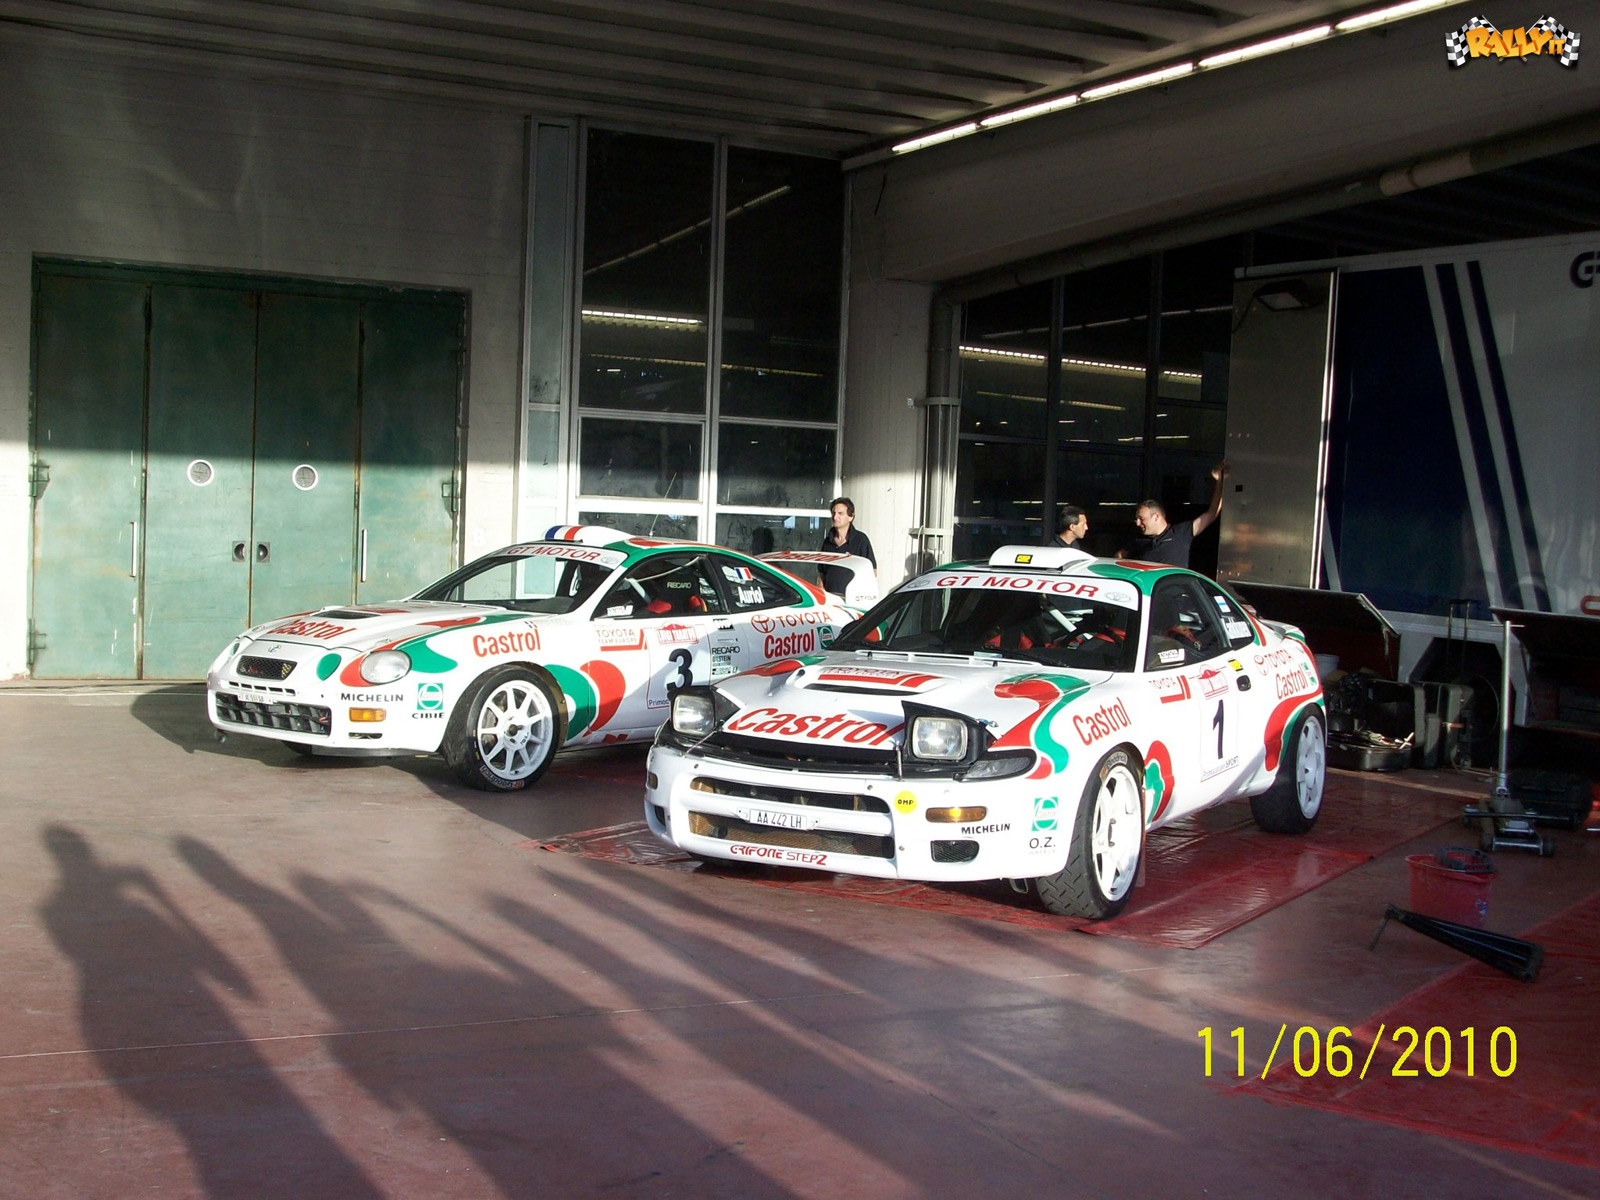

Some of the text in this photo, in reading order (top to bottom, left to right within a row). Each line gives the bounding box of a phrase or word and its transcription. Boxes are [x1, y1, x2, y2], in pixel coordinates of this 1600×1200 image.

[507, 546, 601, 561] GT MOTOR
[667, 581, 692, 589] RECARO
[936, 576, 1099, 597] GT MOTOR
[738, 586, 765, 604] Auriol
[776, 611, 833, 628] TOYOTA
[266, 618, 357, 640] Castrol
[596, 629, 635, 638] TOYOTA
[472, 628, 541, 657] Castrol
[711, 645, 741, 655] RECARO
[764, 629, 815, 659] Castrol
[666, 648, 693, 692] 3
[1276, 664, 1309, 700] Castrol
[340, 692, 404, 702] MICHELIN
[728, 707, 904, 746] Castrol
[1072, 696, 1132, 746] Castrol
[1212, 698, 1225, 760] 1
[897, 798, 914, 806] OMP
[757, 811, 802, 828] AA 442 LH
[961, 823, 1011, 835] MICHELIN
[729, 844, 783, 859] GRIFONE
